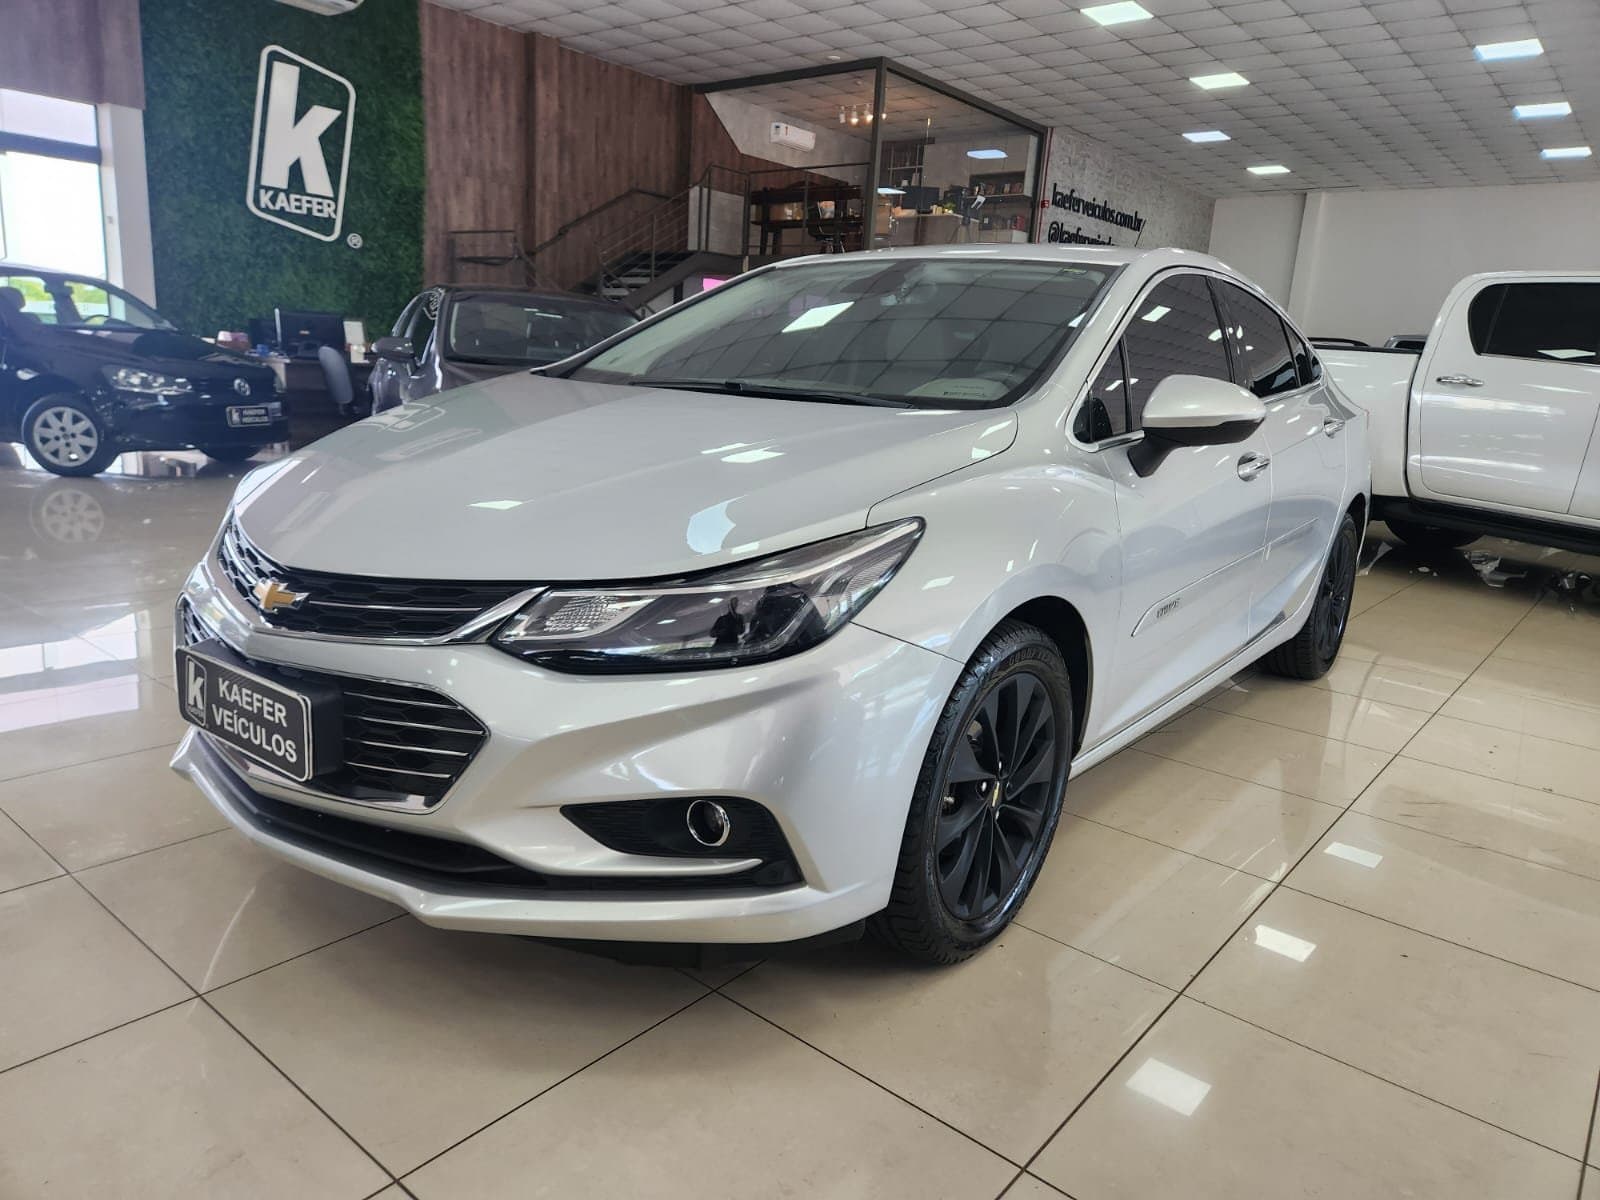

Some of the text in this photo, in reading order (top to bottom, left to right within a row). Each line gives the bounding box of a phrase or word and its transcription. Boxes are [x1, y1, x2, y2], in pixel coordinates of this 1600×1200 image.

[259, 188, 337, 219] KAEFER
[218, 677, 288, 728] KAEFER
[212, 703, 298, 763] VEÍCULOS
